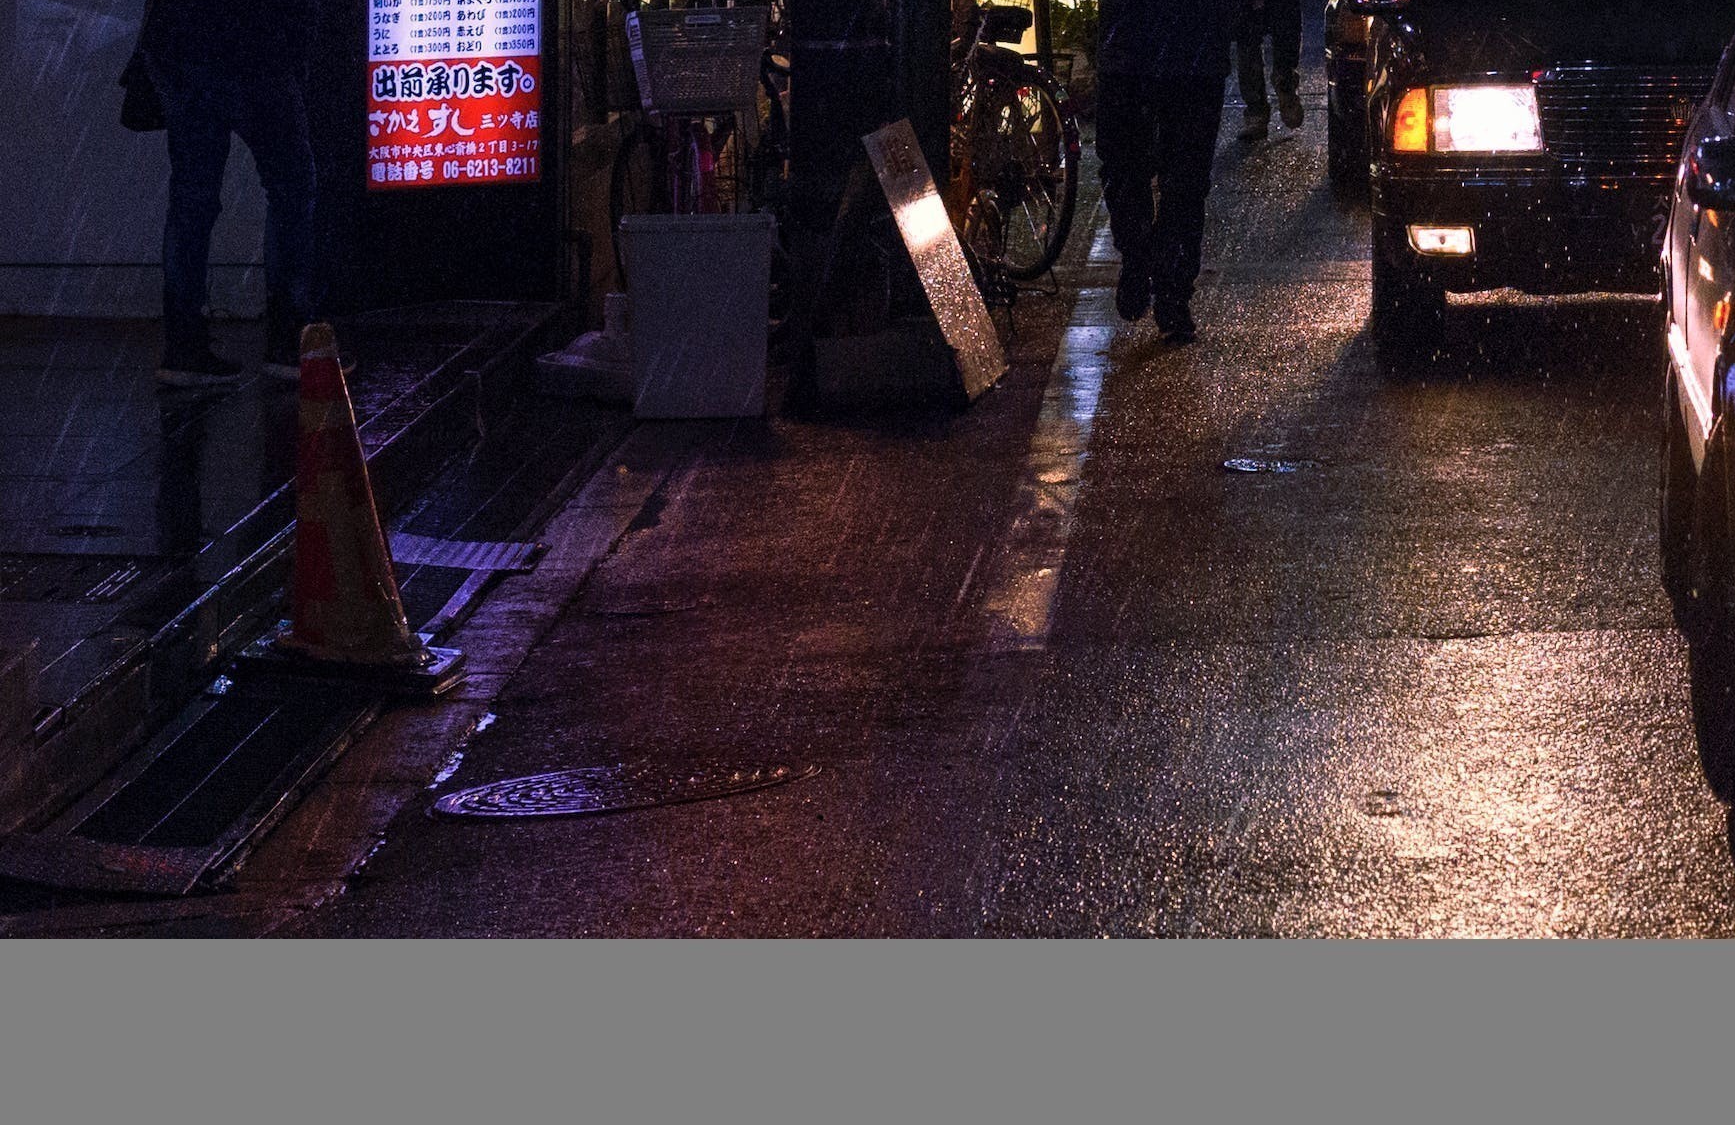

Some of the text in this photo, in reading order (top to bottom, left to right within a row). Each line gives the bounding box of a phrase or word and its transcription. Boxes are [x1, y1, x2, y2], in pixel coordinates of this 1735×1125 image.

[374, 13, 400, 24] うなぎ
[457, 9, 485, 20] あわび
[374, 29, 390, 40] うに
[373, 43, 399, 55] 上とろ
[375, 64, 533, 98] 出前承ります。
[443, 158, 535, 178] 06-6213-8211
